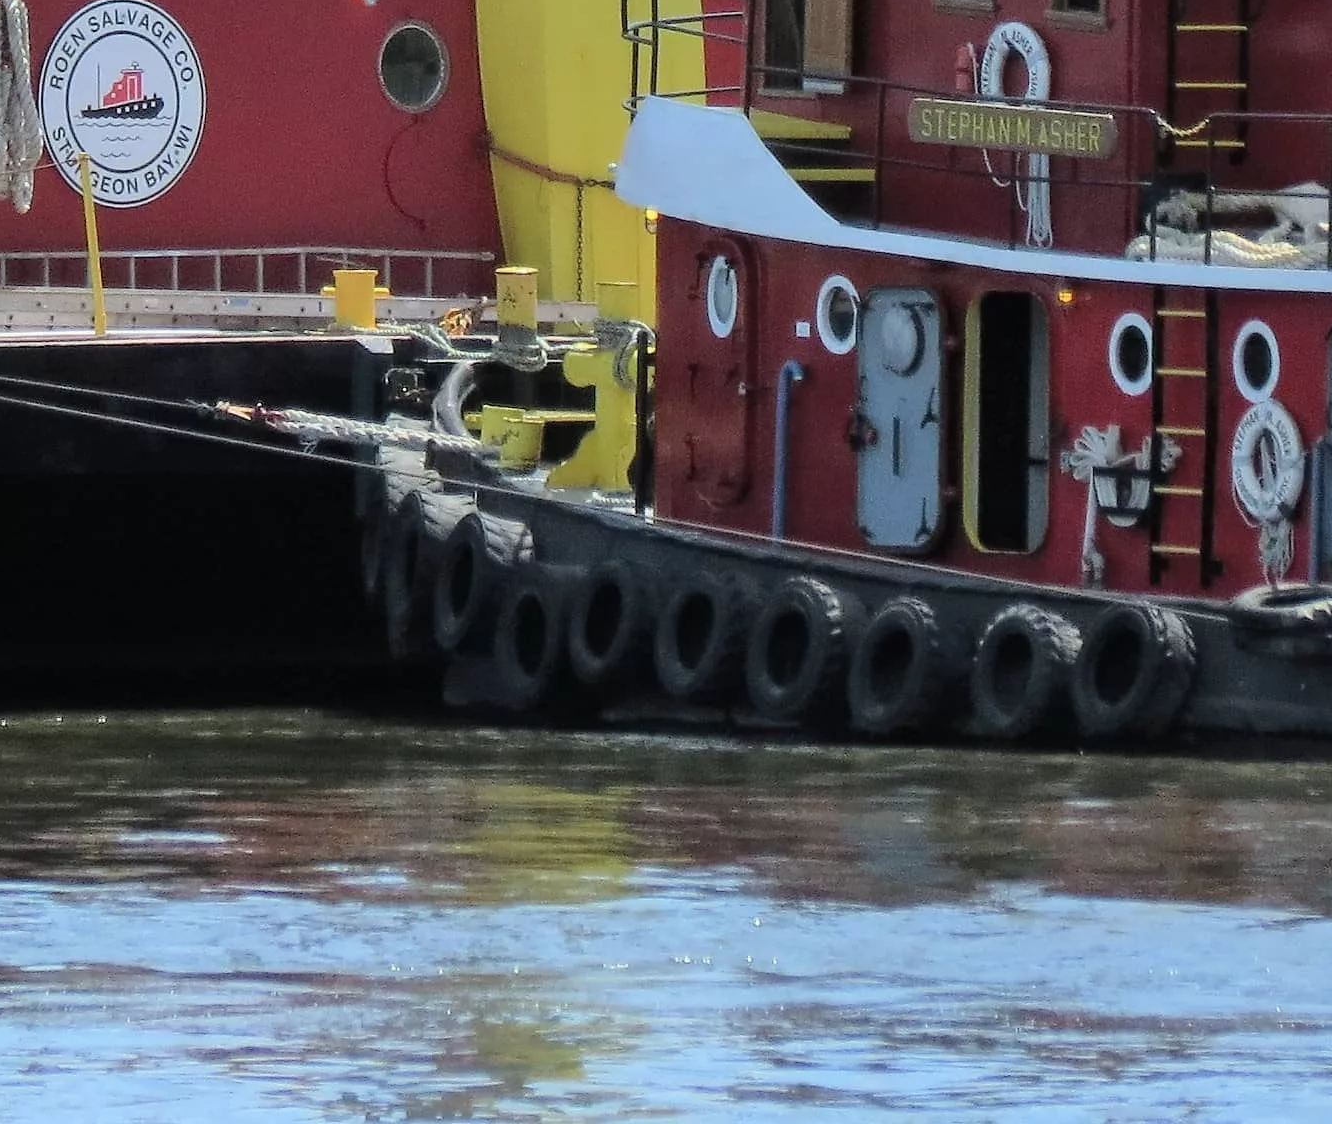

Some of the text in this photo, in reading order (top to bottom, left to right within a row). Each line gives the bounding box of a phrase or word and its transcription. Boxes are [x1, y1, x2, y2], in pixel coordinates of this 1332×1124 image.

[49, 27, 87, 90] ROEN
[88, 8, 178, 48] SALVAGE
[174, 125, 193, 149] WI
[920, 108, 1010, 145] STEPHAN
[1038, 121, 1101, 152] ASHER
